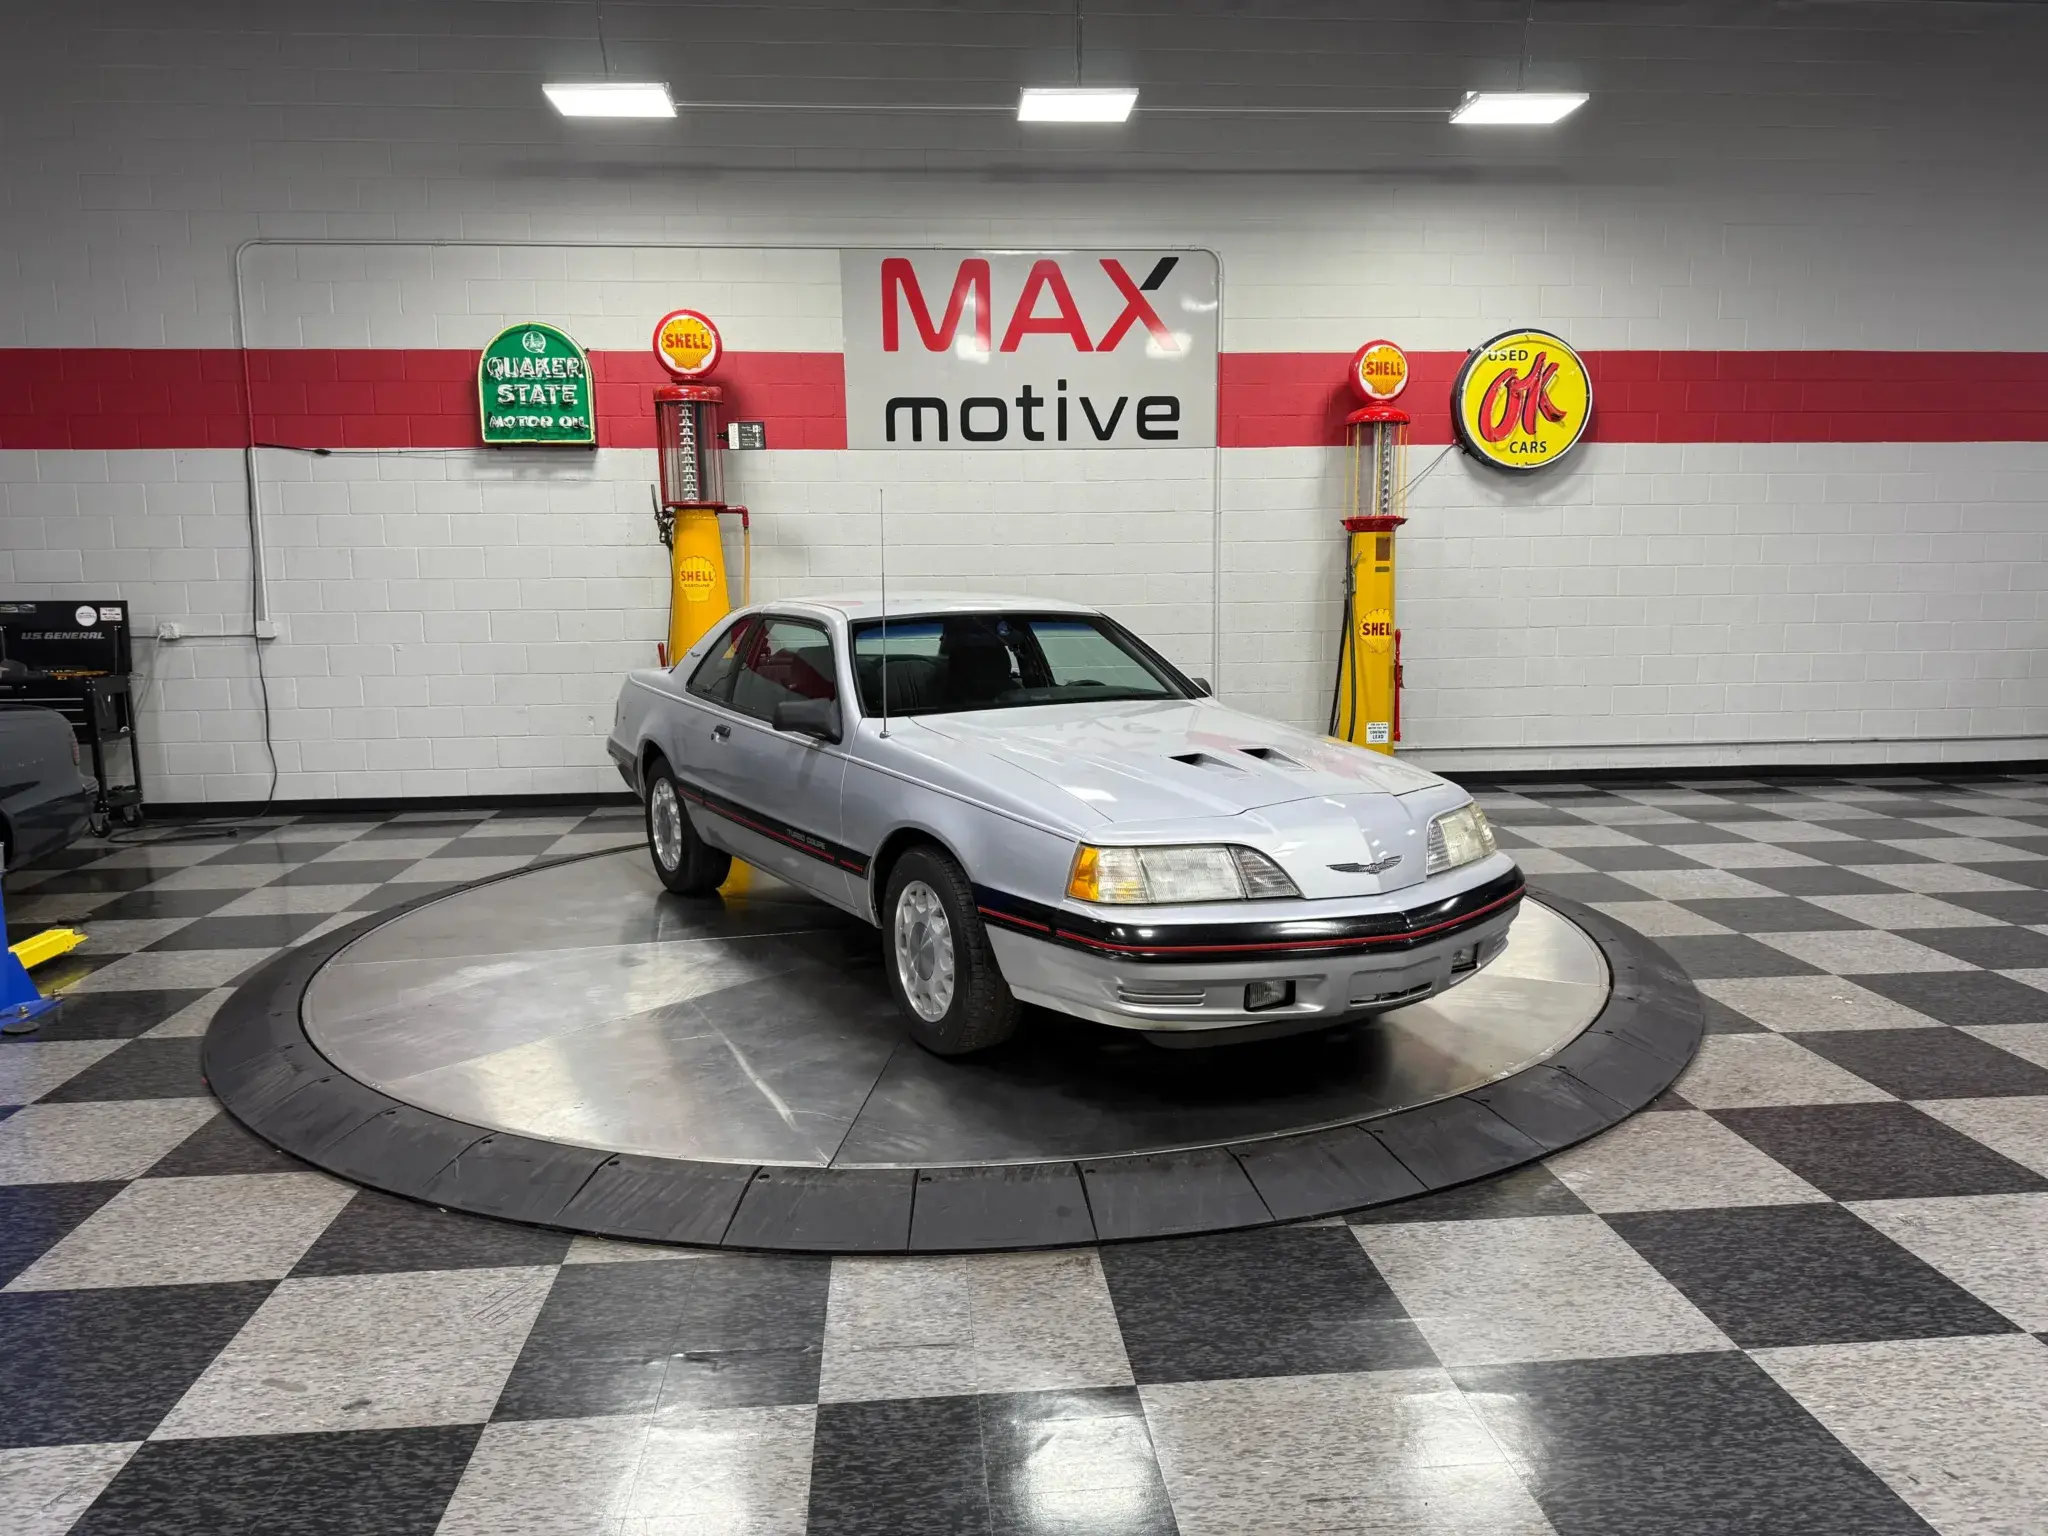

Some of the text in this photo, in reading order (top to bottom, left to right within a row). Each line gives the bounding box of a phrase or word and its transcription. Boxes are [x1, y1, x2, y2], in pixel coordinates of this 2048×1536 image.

[881, 256, 1181, 353] MAX
[665, 333, 709, 349] SHELL
[1488, 349, 1529, 361] USED
[487, 356, 584, 381] QUAKER
[1366, 361, 1402, 376] SHELL
[497, 383, 579, 406] STATE
[1478, 351, 1568, 442] OK
[885, 379, 1181, 442] motive
[489, 415, 590, 429] MOTOR OIL
[1509, 440, 1548, 454] CARS
[681, 571, 714, 582] SHELL
[44, 632, 105, 640] GENERAL
[786, 829, 826, 850] TURBO COUPE
